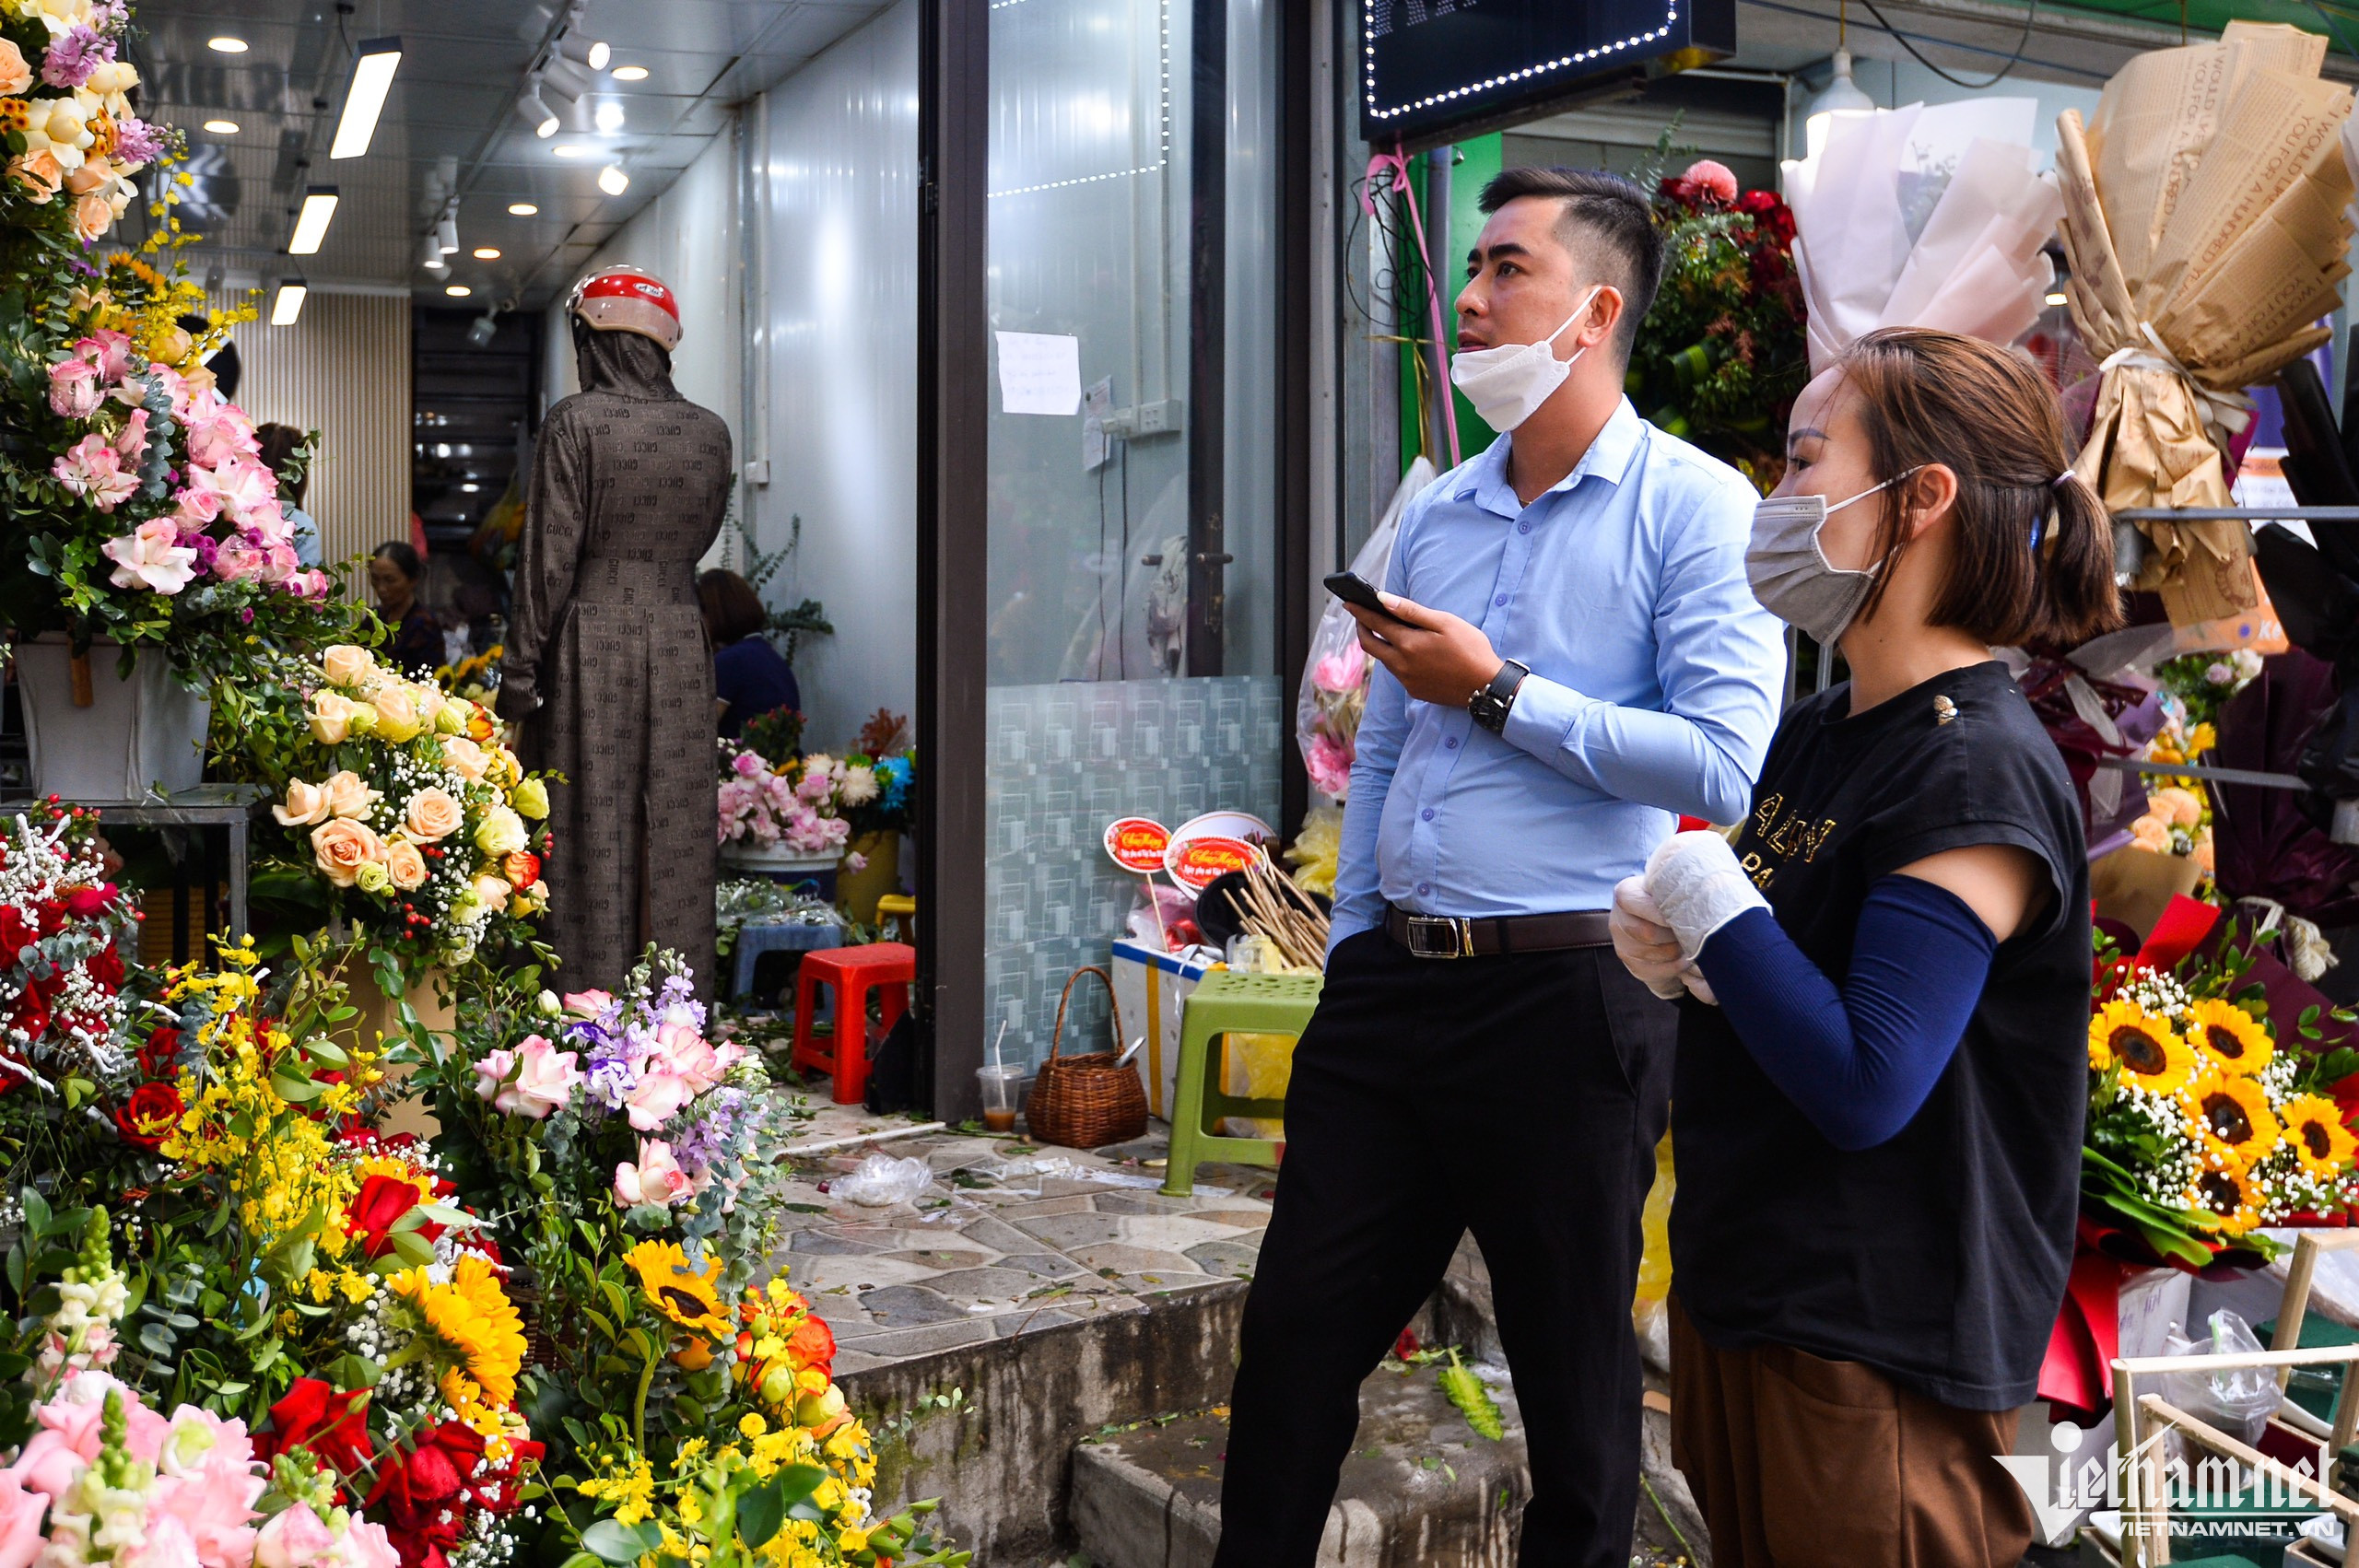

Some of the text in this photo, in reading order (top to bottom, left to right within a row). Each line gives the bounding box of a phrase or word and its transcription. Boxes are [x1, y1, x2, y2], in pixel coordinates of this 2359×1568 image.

[2192, 59, 2208, 93] YOU
[2204, 53, 2224, 111] WOULD
[2284, 115, 2317, 155] YOU
[2286, 121, 2333, 176] WOULD
[2263, 149, 2291, 181] FOR
[2201, 194, 2255, 263] HUNDRED
[656, 426, 681, 436] GUCCI
[634, 441, 657, 453] GUCCI
[614, 460, 638, 471] GUCCI
[659, 476, 684, 487] GUCCI
[611, 512, 635, 523] GUCCI
[546, 525, 573, 536] GUCCI
[607, 558, 619, 584] GUCCI
[618, 624, 642, 636] GUCCI
[596, 639, 620, 651] GUCCI
[593, 744, 615, 755] GUCCI
[591, 796, 613, 806] GUCCI
